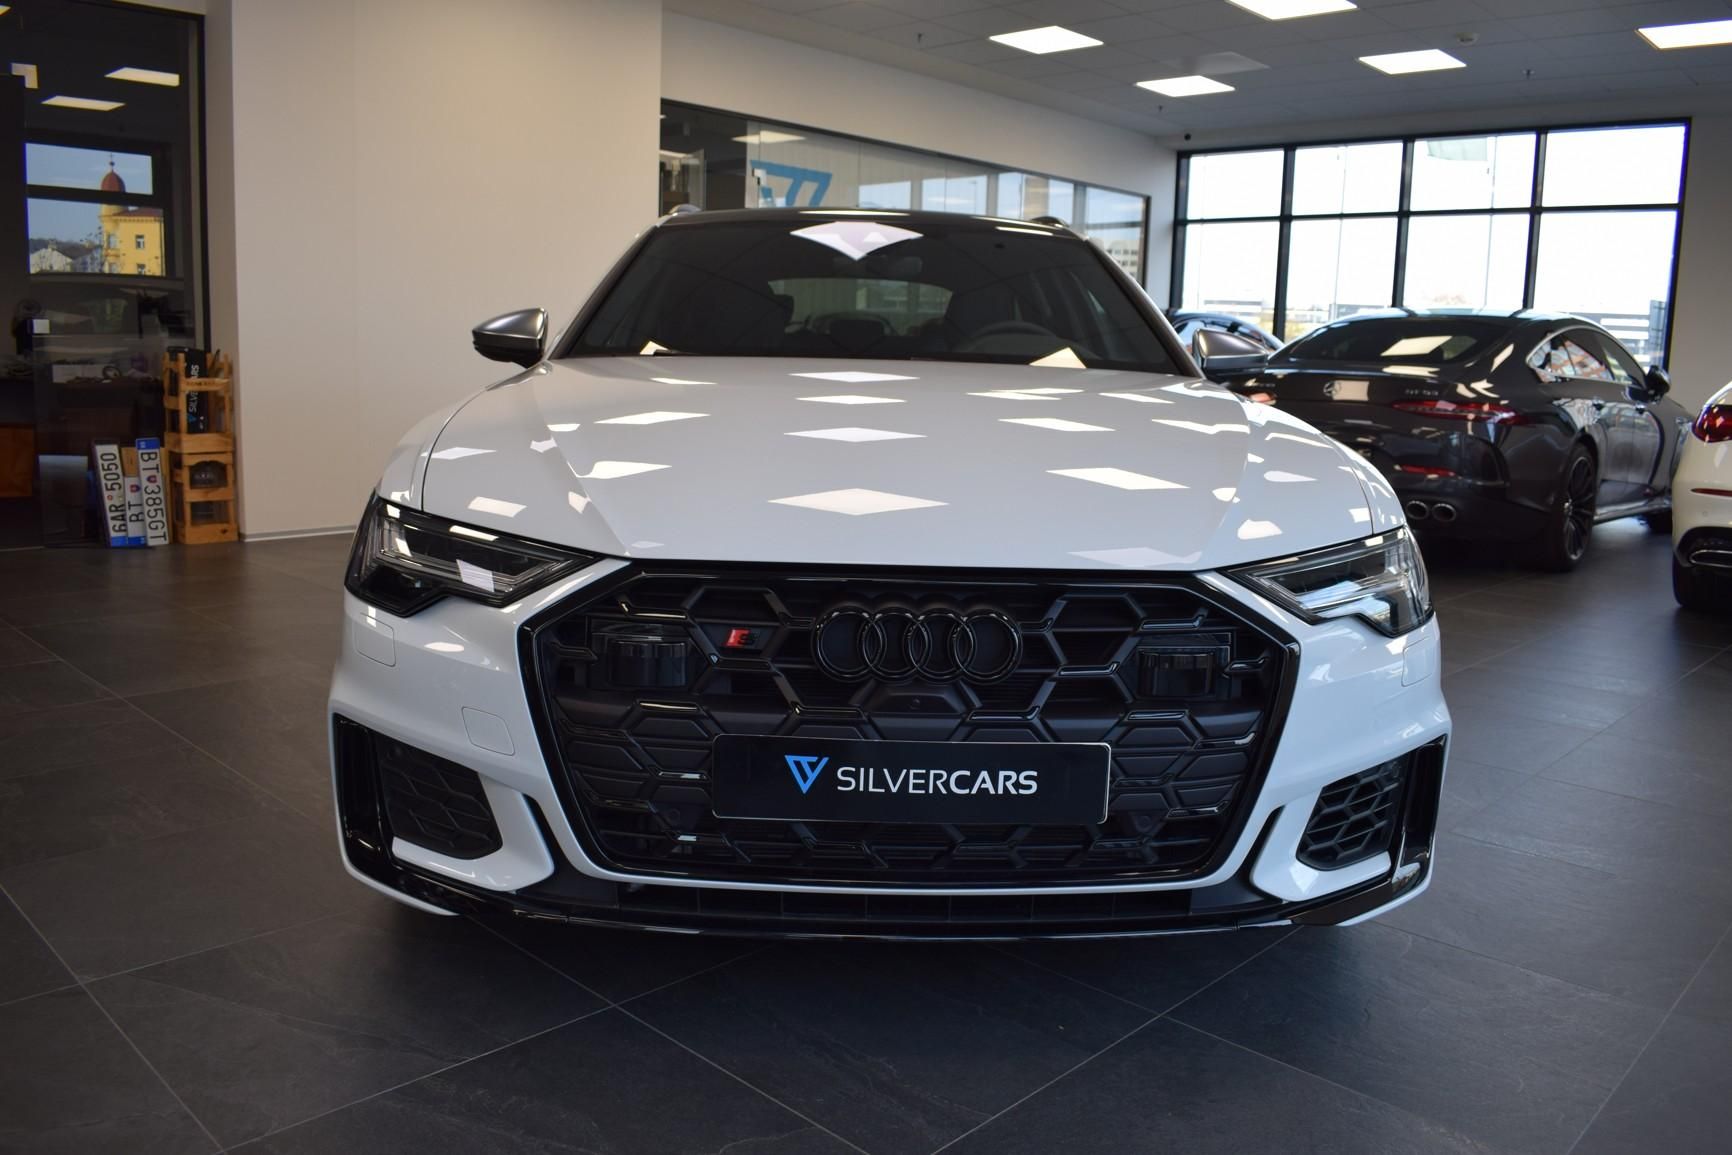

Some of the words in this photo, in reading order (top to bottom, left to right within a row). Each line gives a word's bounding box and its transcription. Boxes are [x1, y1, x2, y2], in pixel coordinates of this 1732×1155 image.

[100, 452, 122, 492] 5050
[144, 485, 167, 541] 385GT
[836, 766, 1039, 796] SILVERCARS
